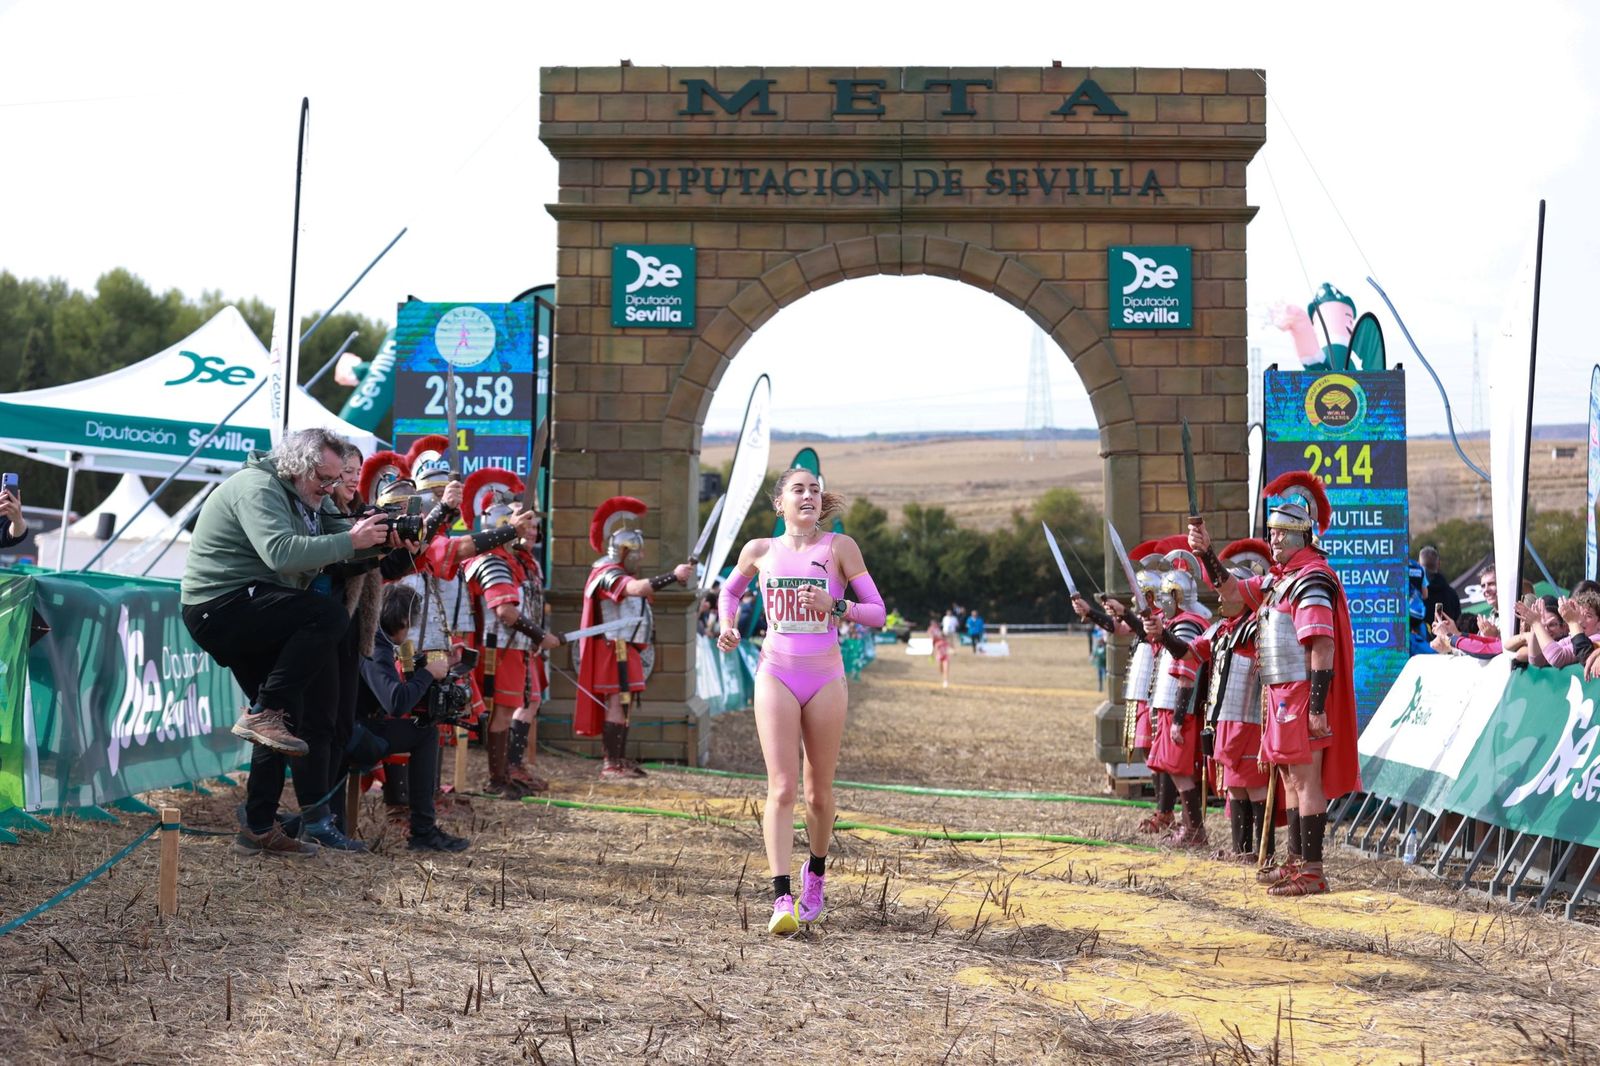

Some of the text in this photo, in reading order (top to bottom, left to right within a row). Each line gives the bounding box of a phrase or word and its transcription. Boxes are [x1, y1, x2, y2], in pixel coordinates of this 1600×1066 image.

[676, 78, 1129, 116] META
[629, 167, 1165, 197] DIPUTACION DE SEVILLA
[625, 294, 682, 308] Diputación
[625, 305, 682, 323] Sevilla
[1122, 296, 1179, 310] Diputación
[1122, 307, 1179, 324] Sevilla
[424, 375, 514, 416] 28:58
[85, 420, 256, 452] Diputación Sevilla
[456, 429, 469, 451] 1
[1303, 444, 1374, 485] 2:14
[1571, 755, 1600, 802] Se
